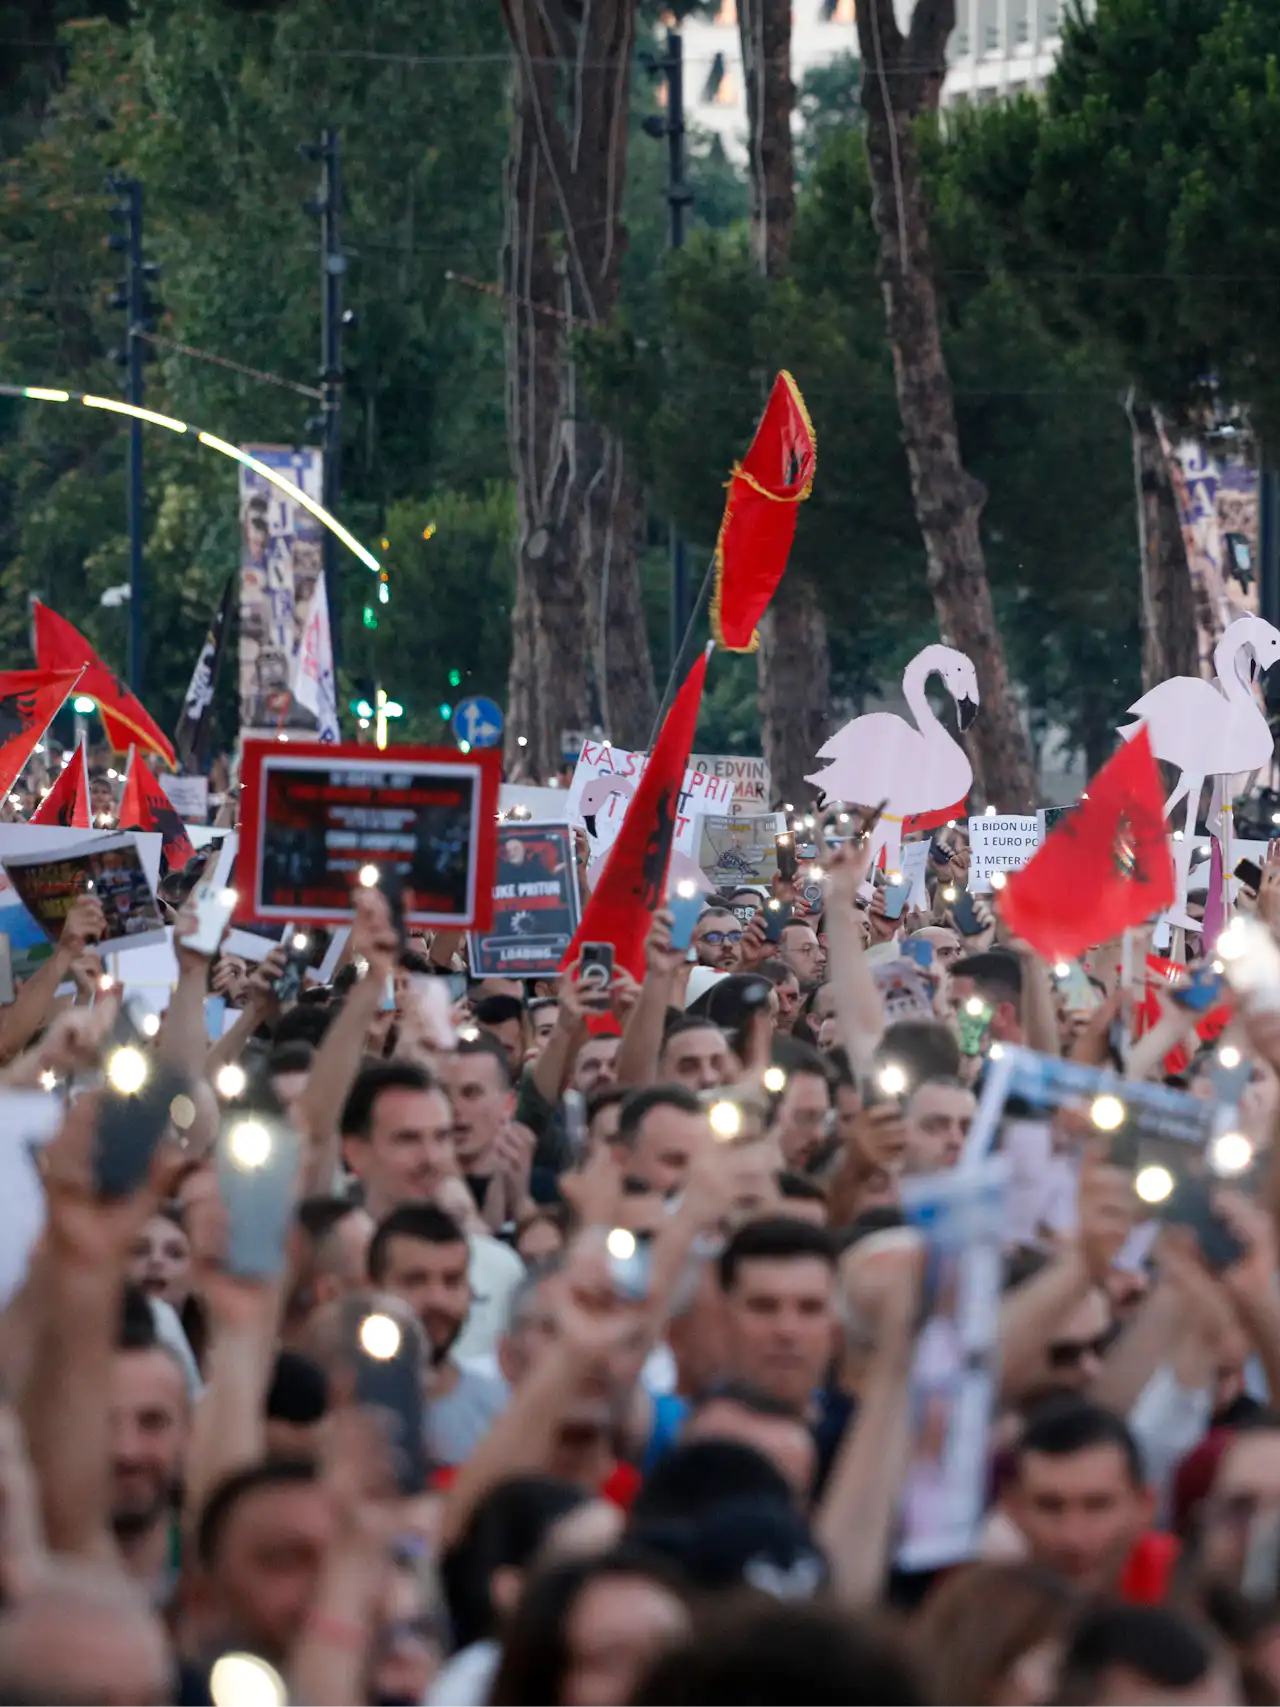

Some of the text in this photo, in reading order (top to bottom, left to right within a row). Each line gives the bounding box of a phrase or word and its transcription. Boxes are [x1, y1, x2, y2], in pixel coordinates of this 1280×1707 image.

[714, 760, 765, 779] EDVIN
[973, 823, 979, 831] 1
[982, 823, 1017, 831] BIDON
[983, 837, 989, 846] 1
[992, 837, 1022, 846] EURO
[976, 856, 981, 865] 1
[984, 856, 1021, 865] METER
[976, 870, 981, 878] 1
